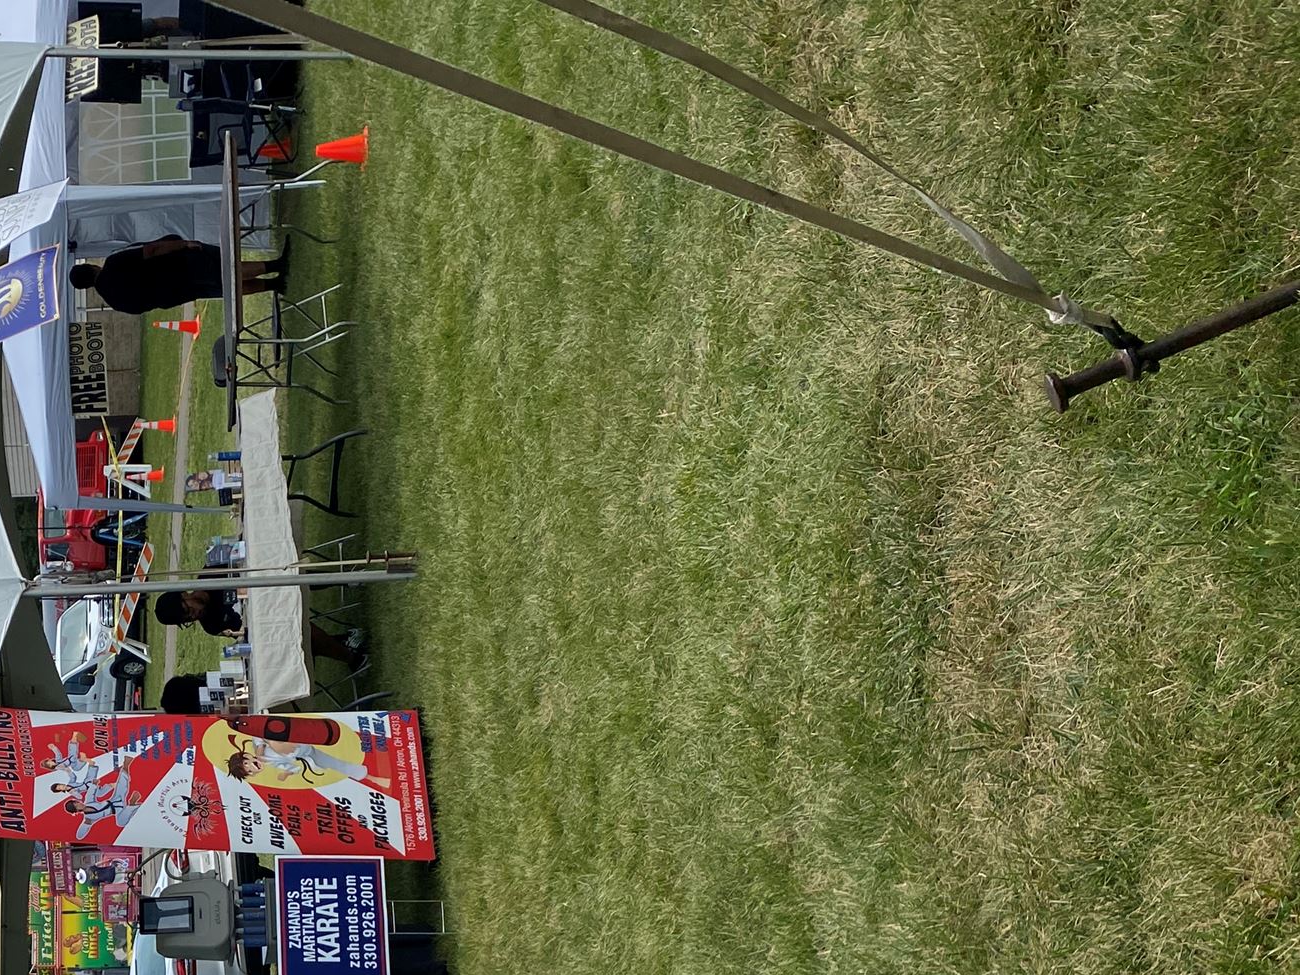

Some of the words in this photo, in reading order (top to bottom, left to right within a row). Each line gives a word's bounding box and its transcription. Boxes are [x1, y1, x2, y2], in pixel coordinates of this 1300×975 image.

[81, 19, 96, 67] BOTH
[69, 323, 85, 376] PHOTO
[85, 322, 104, 373] BOOTH
[70, 373, 107, 415] FREE
[92, 714, 108, 726] US!
[357, 716, 372, 752] REGISTER
[372, 718, 388, 752] ONLINE!
[391, 716, 400, 736] 44313
[16, 711, 36, 777] HEADQUARTERS
[93, 729, 109, 753] JOIN
[395, 737, 403, 746] OH
[406, 727, 420, 788] www.zahands.com
[396, 749, 406, 767] Akron,
[399, 772, 407, 780] Rd
[239, 796, 252, 813] OUT
[401, 783, 412, 812] Peninsula
[241, 814, 253, 844] CHECK
[253, 812, 262, 825] OUR
[267, 793, 284, 849] AWESOME
[286, 804, 301, 836] DEALS
[304, 811, 313, 821] ON
[316, 802, 334, 835] TRIAL
[334, 796, 355, 844] OFFERS
[357, 814, 368, 829] AND
[369, 792, 391, 850] PACKAGES
[405, 814, 414, 833] Akron
[415, 794, 428, 841] 330.926.2001
[406, 834, 416, 851] 1576
[53, 852, 63, 868] CAKES
[54, 870, 65, 890] FUNNEL
[301, 878, 314, 907] ARTS
[41, 910, 53, 959] Fried
[287, 891, 301, 948] ZAHAND'S
[315, 878, 340, 962] KARATE
[346, 875, 360, 968] zahands.com
[360, 876, 377, 969] 330.926.2001
[88, 926, 98, 959] DOGS
[302, 911, 316, 962] MARTIAL
